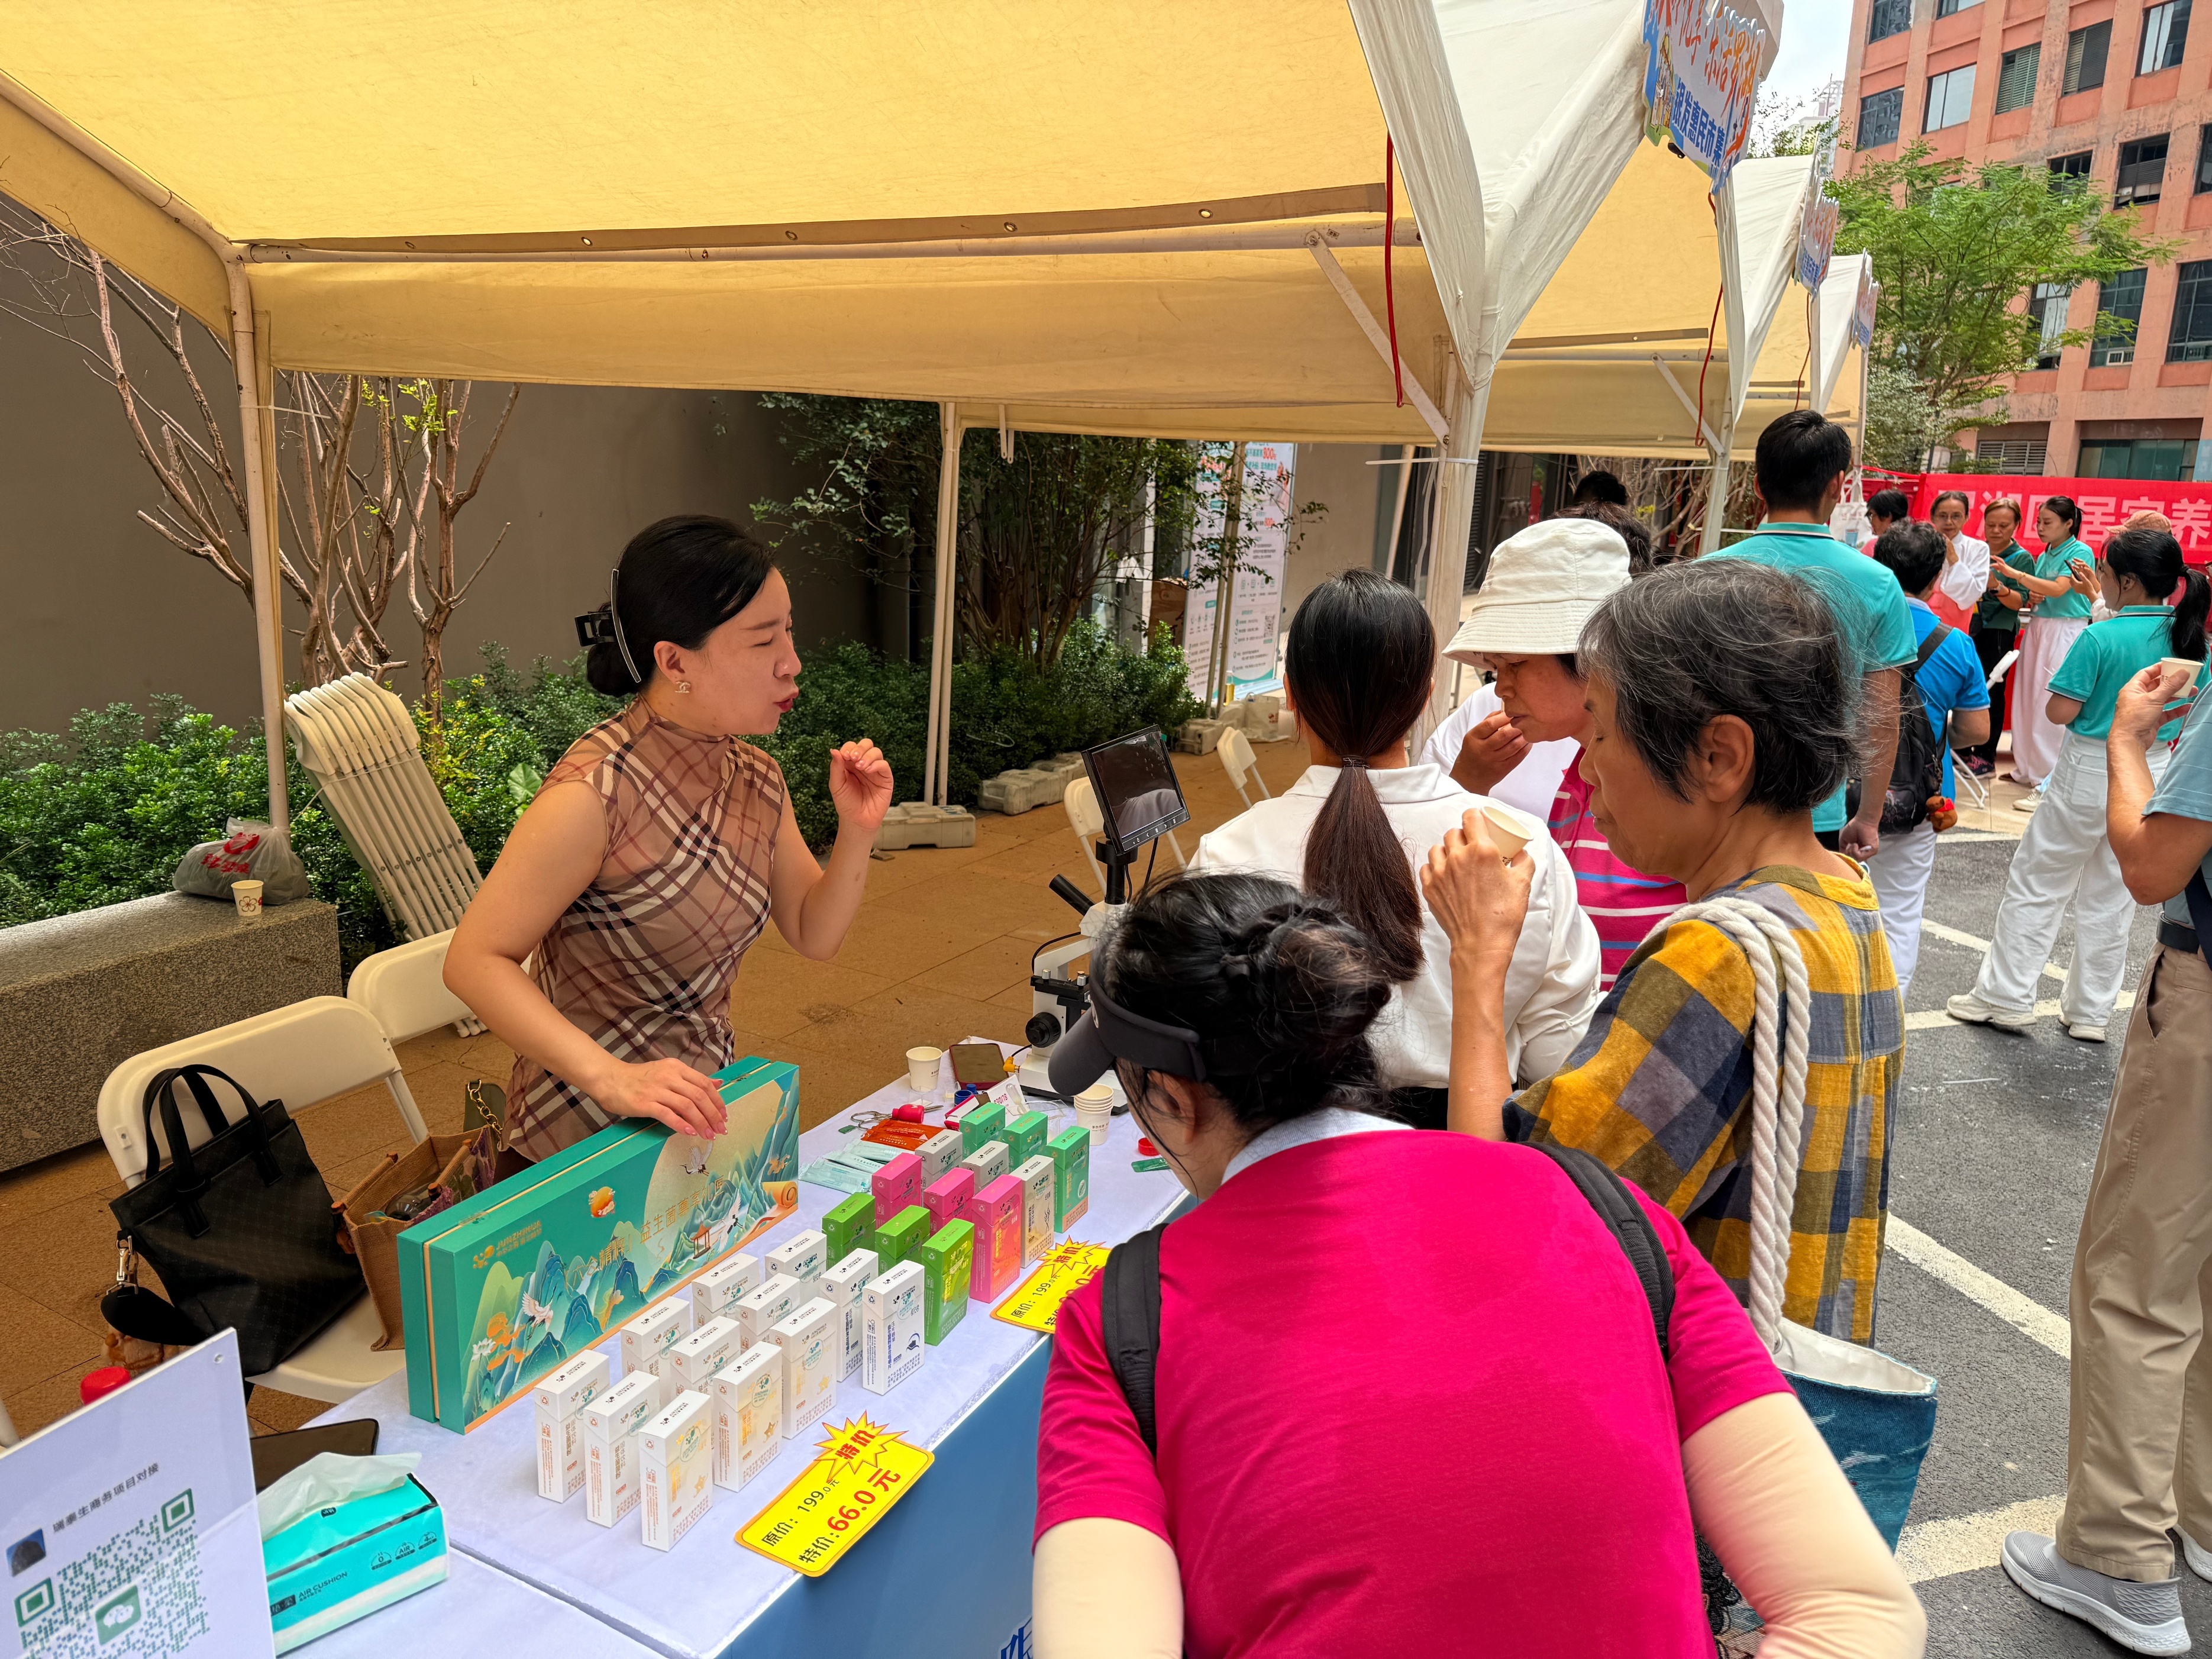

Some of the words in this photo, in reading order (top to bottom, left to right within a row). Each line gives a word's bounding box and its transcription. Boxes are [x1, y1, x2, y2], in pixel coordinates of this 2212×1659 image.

[1672, 77, 1725, 167] 银发惠民市集
[1053, 1247, 1081, 1263] 特价
[835, 1430, 876, 1460] 特价
[399, 1545, 410, 1554] AIR
[298, 1588, 313, 1598] AIR
[313, 1571, 347, 1590] CUSHION
